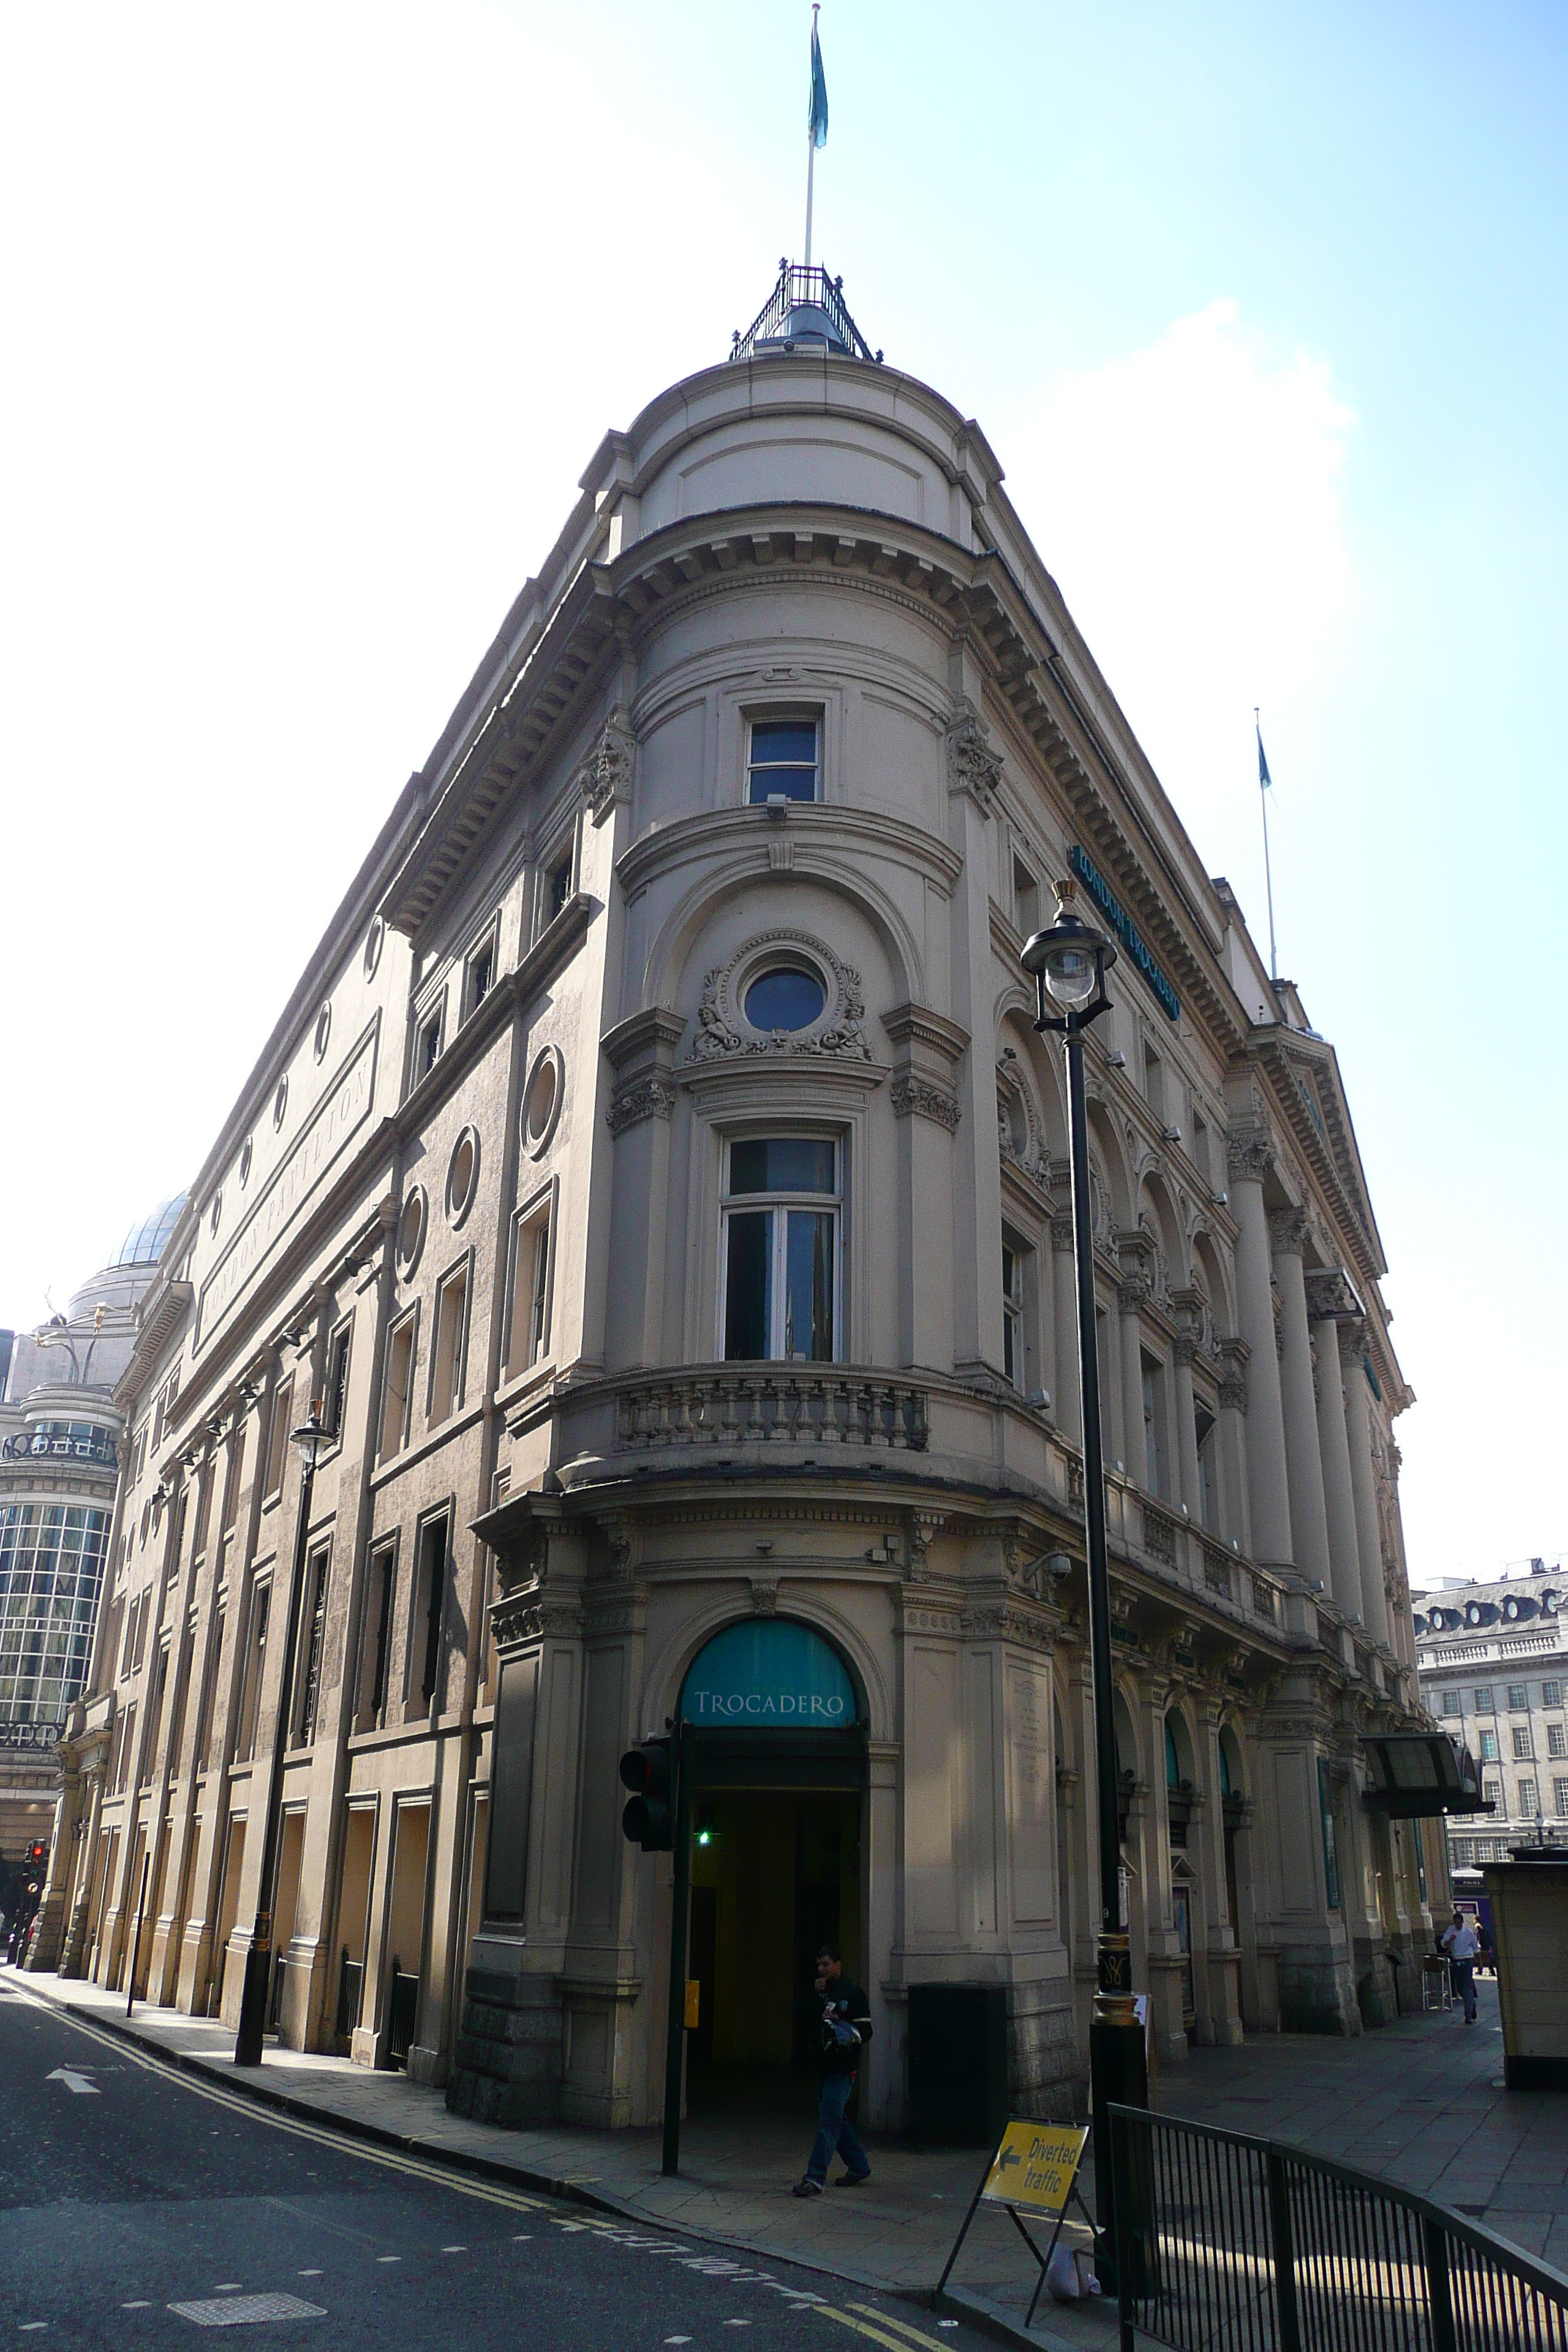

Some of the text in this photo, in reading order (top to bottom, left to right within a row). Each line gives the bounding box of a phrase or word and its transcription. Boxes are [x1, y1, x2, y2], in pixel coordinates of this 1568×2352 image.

[1079, 844, 1180, 1020] LONDON TROCADERO
[1028, 2136, 1080, 2166] Diverted
[1024, 2166, 1062, 2194] traffic
